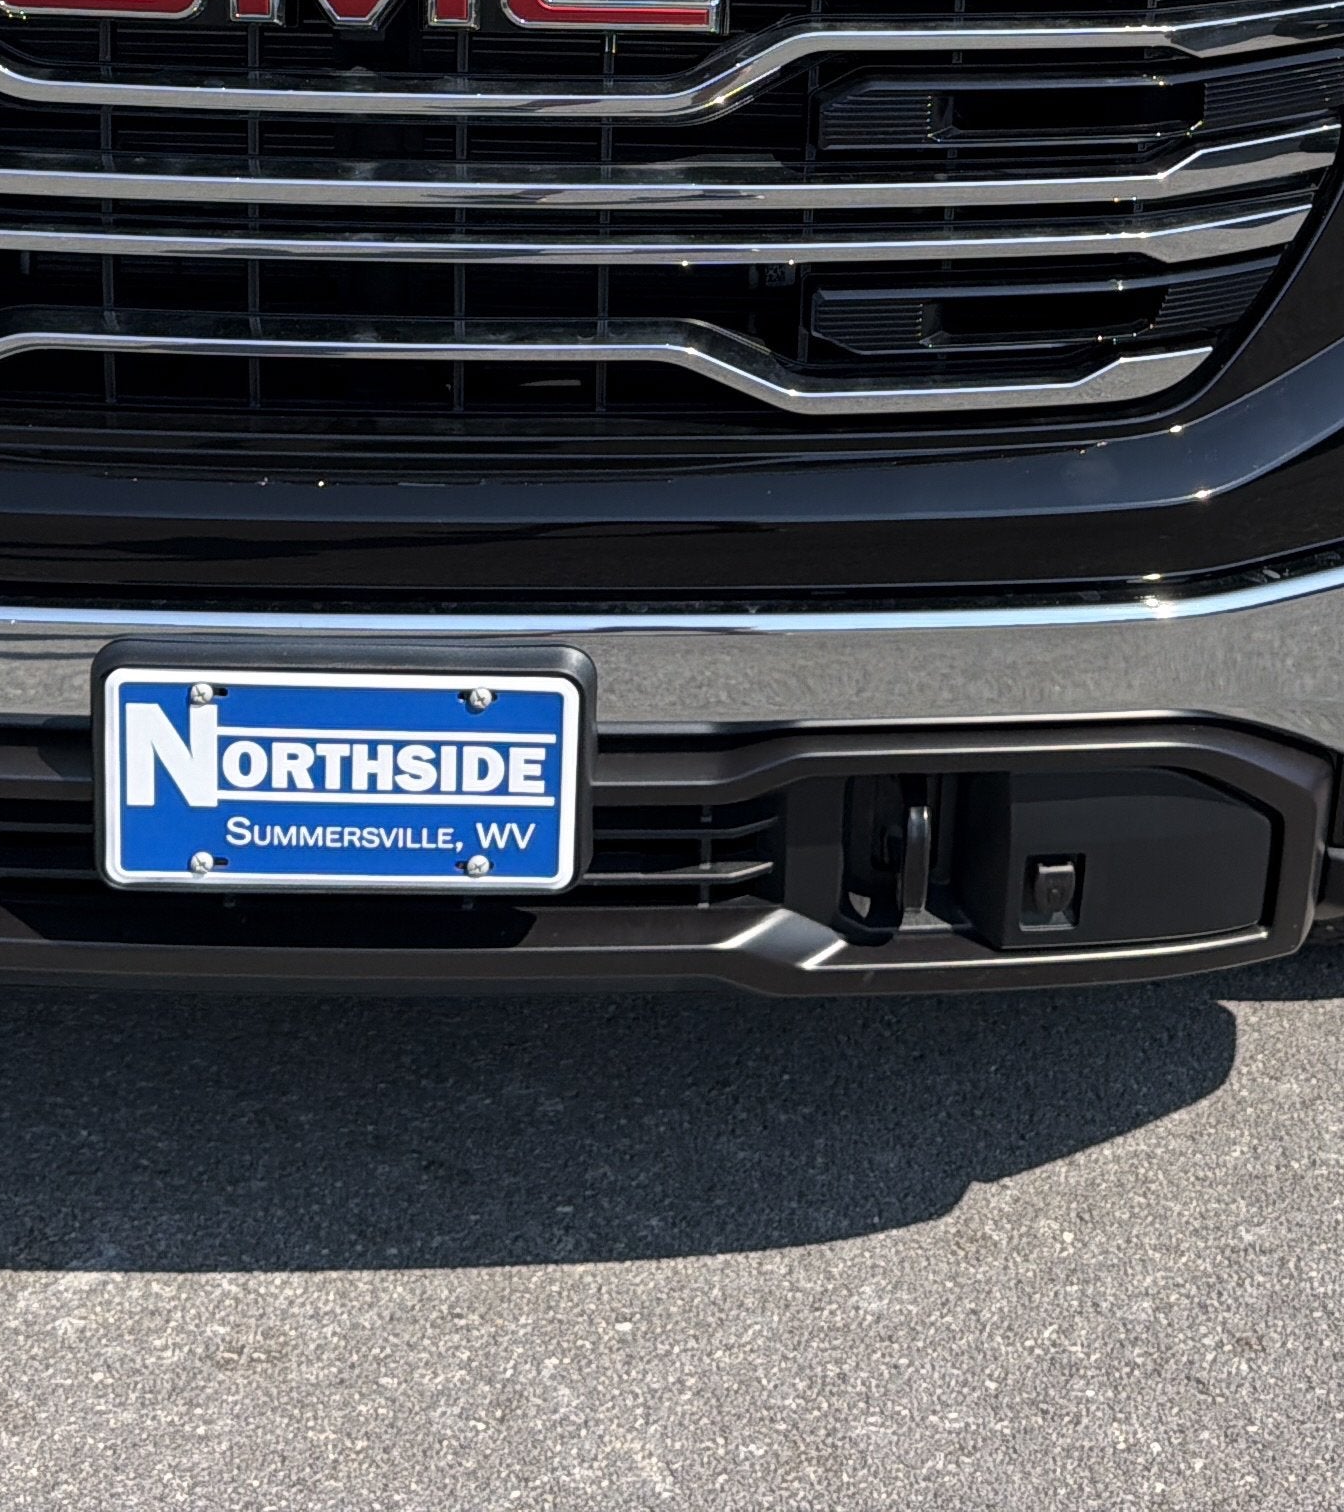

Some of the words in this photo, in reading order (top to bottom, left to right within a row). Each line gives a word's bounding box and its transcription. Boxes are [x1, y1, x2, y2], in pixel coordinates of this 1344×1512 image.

[125, 702, 547, 808] NORTHSIDE
[226, 816, 464, 853] SUMMERSVILLE,
[476, 823, 536, 850] WV
